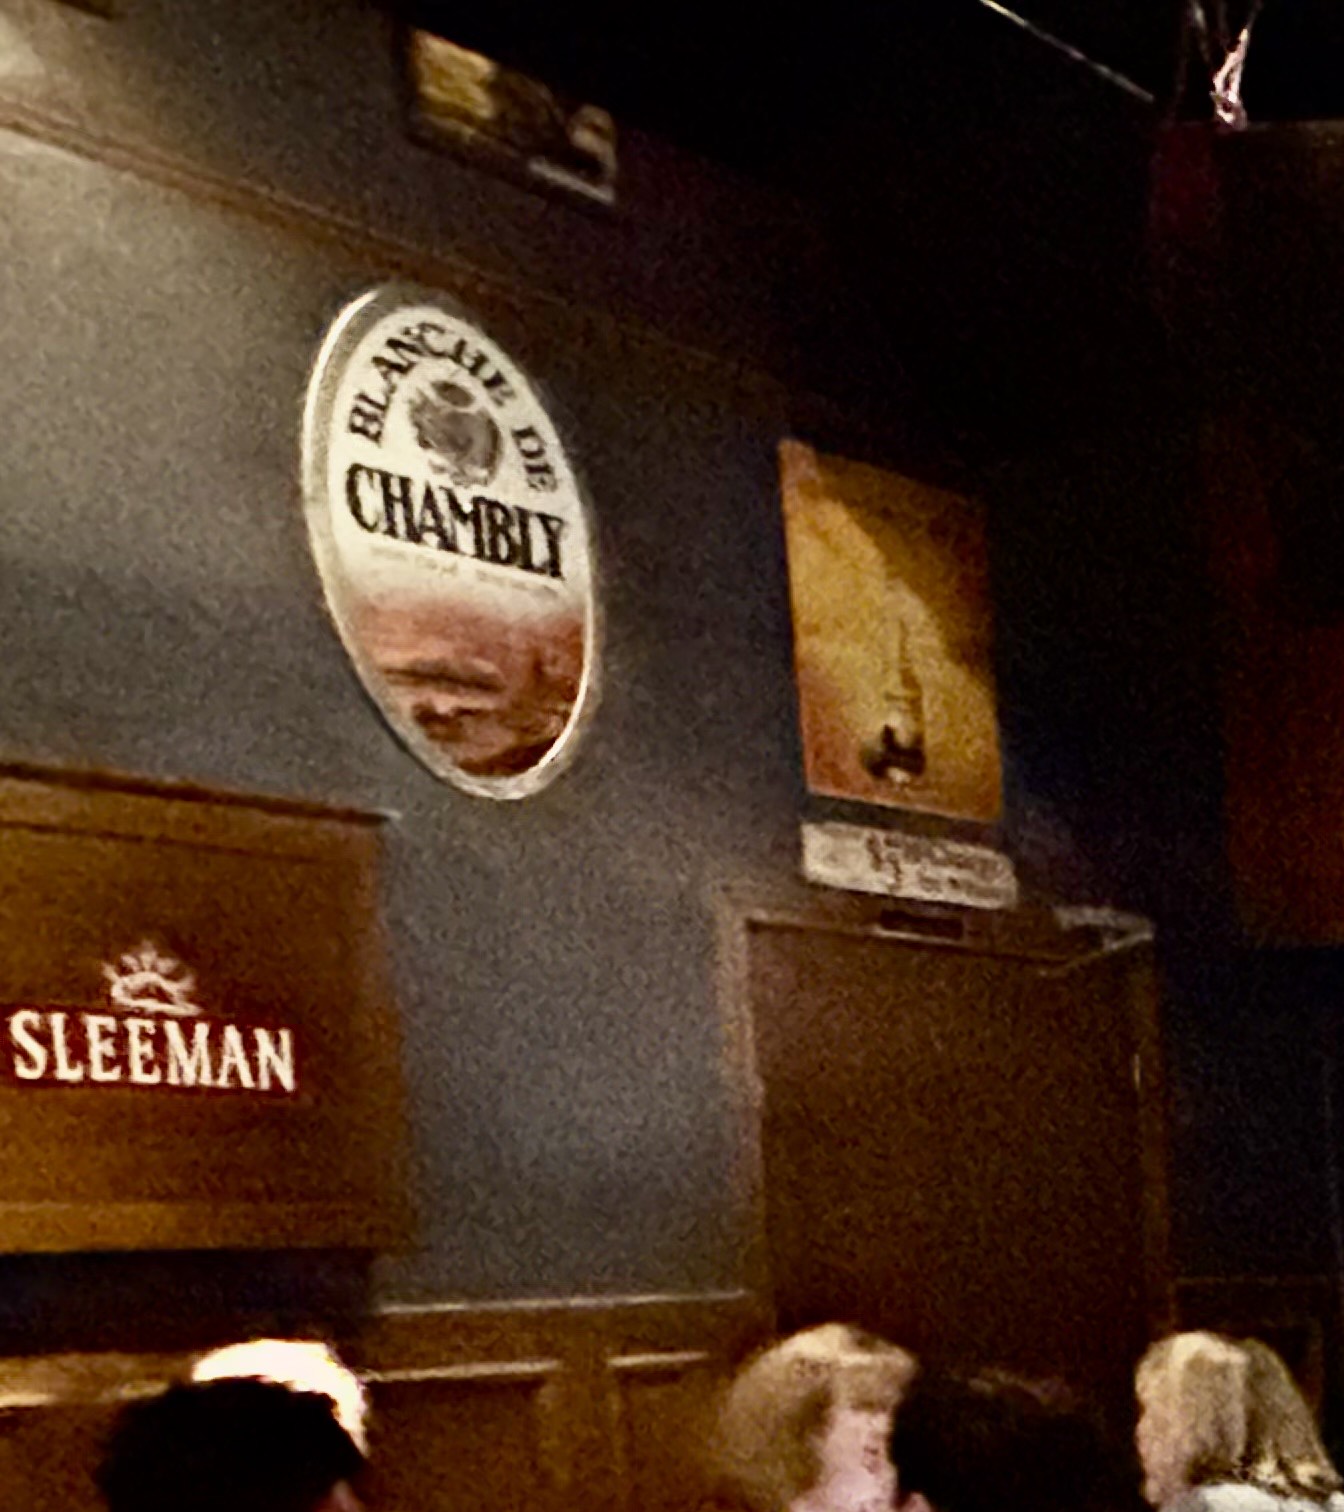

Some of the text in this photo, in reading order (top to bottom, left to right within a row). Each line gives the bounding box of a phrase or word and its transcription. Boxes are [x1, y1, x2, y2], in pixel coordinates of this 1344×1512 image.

[347, 320, 559, 494] BLANCHE DE
[346, 462, 566, 581] CHAMBLY
[8, 1009, 297, 1093] SLEEMAN
